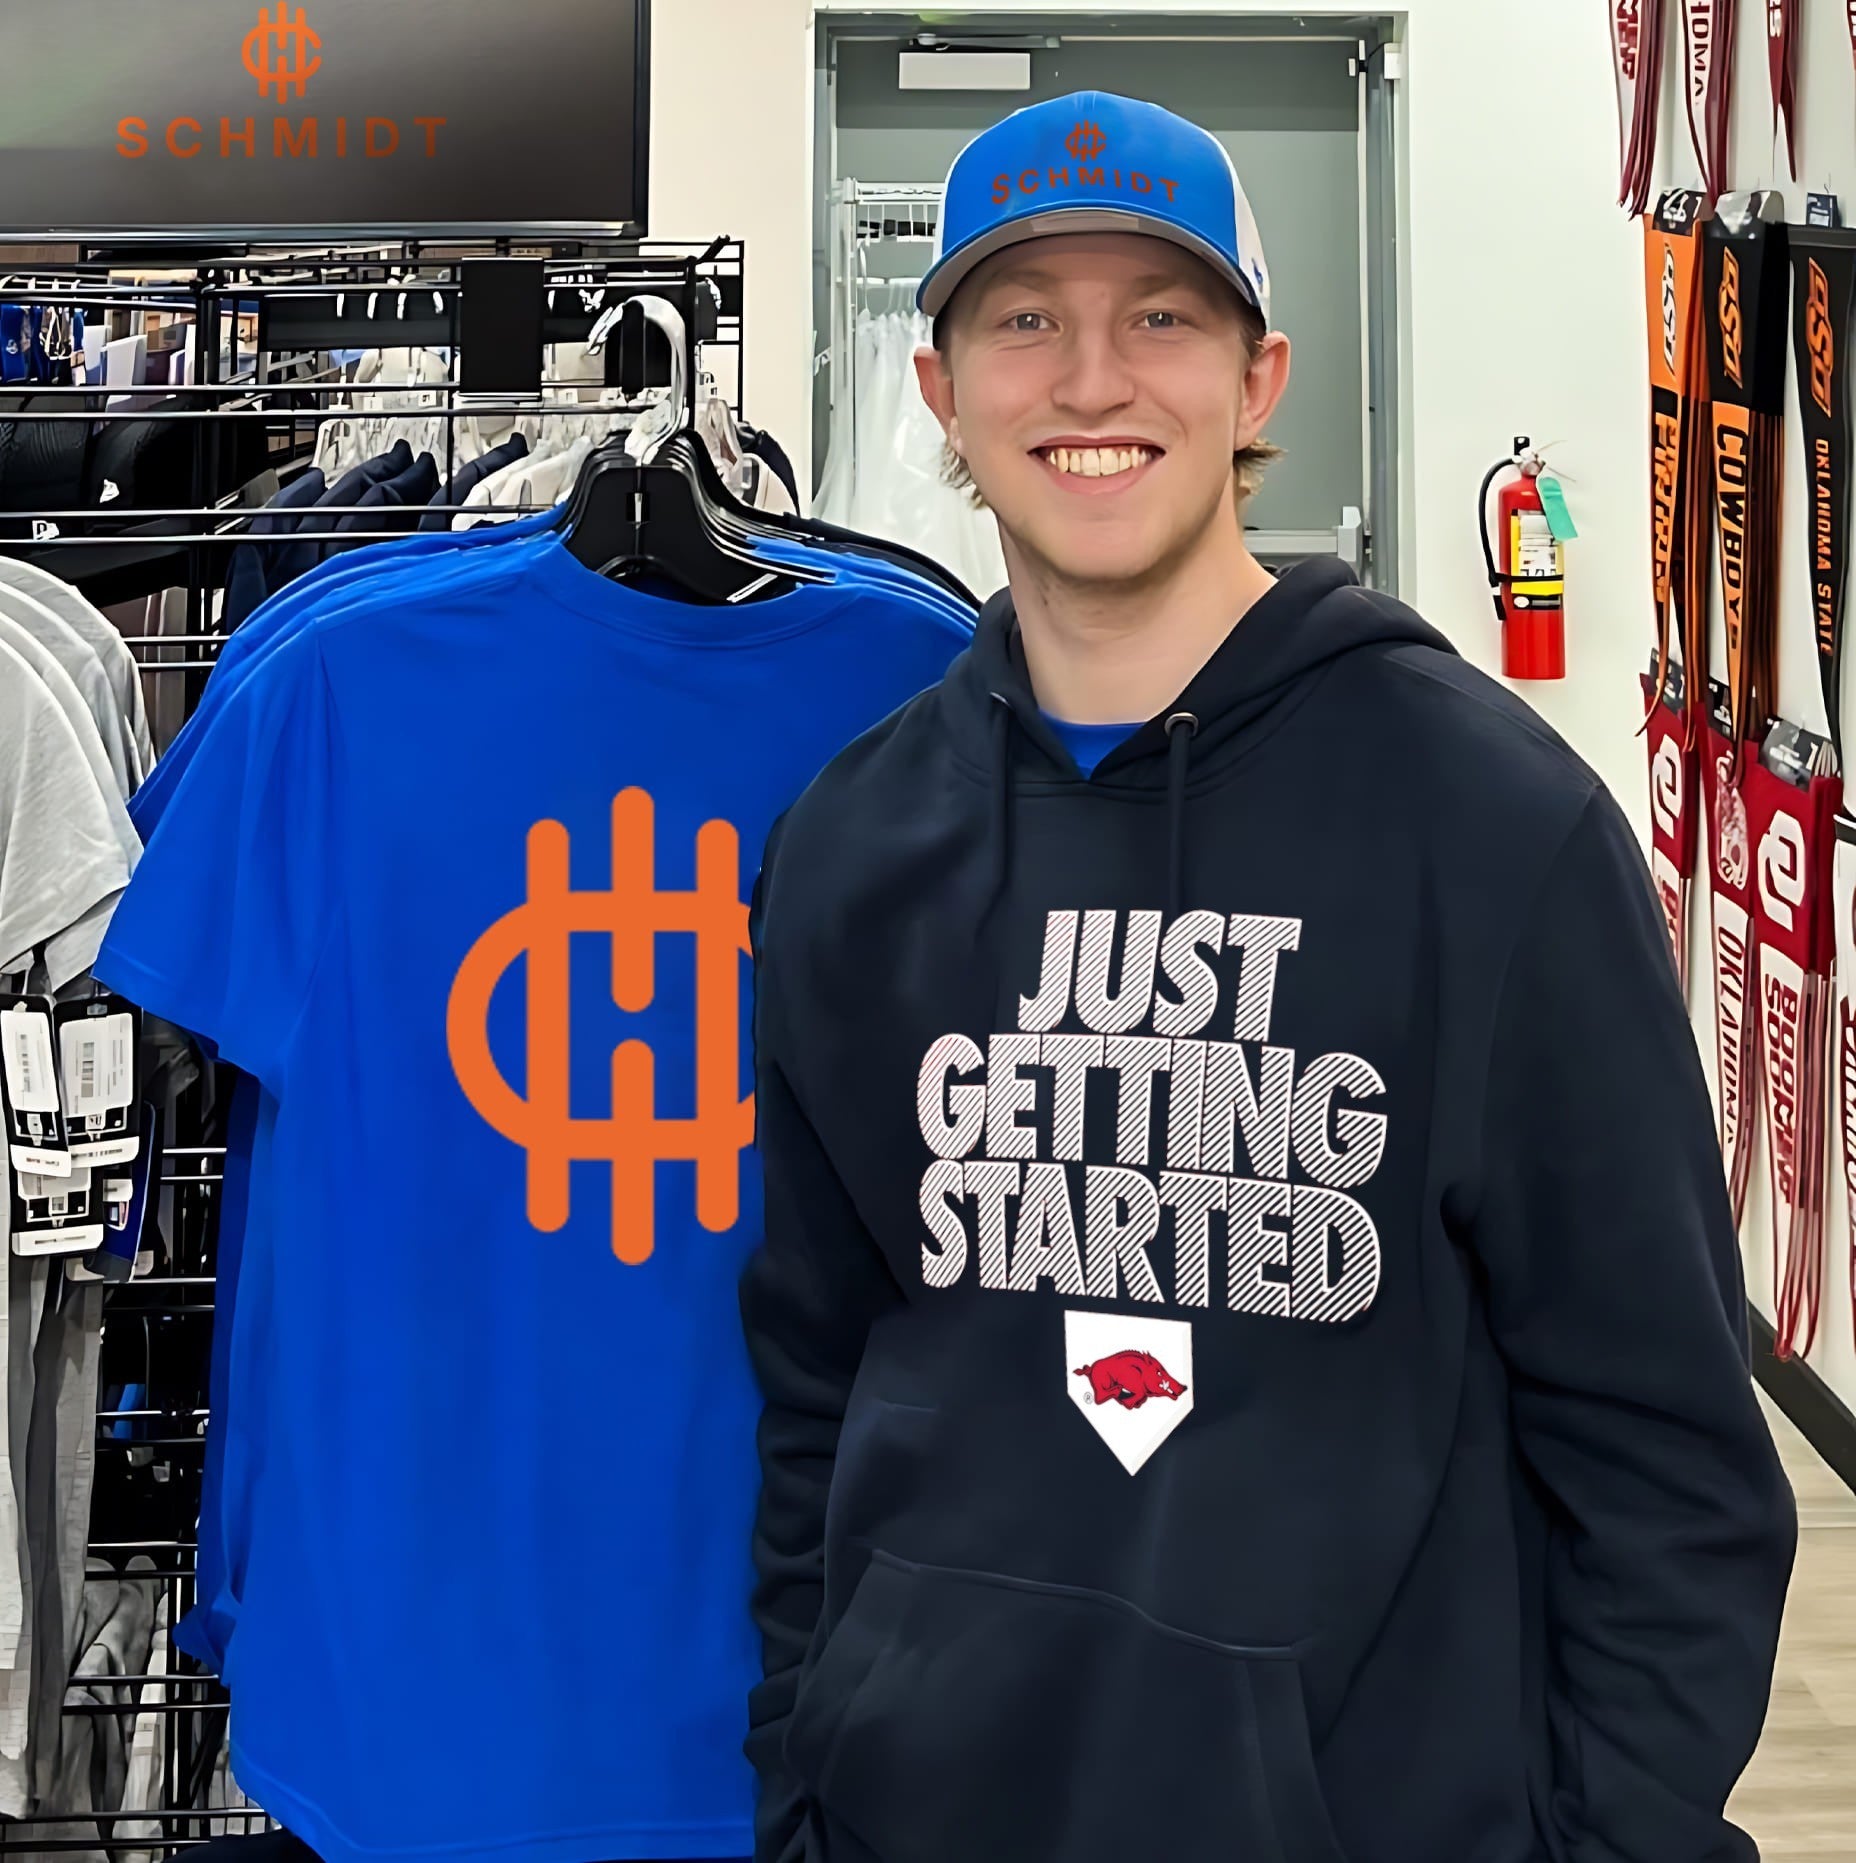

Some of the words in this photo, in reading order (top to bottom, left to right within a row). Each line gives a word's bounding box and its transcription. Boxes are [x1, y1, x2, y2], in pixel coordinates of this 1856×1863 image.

[116, 117, 447, 158] SCHMIDT
[991, 167, 1179, 204] SCHMIDT
[1815, 438, 1832, 570] OKLAHOMA
[1018, 909, 1303, 1042] JUST
[1717, 925, 1745, 1143] OKLAHOMA
[917, 1032, 1388, 1189] GETTING
[919, 1158, 1381, 1323] STARTED
